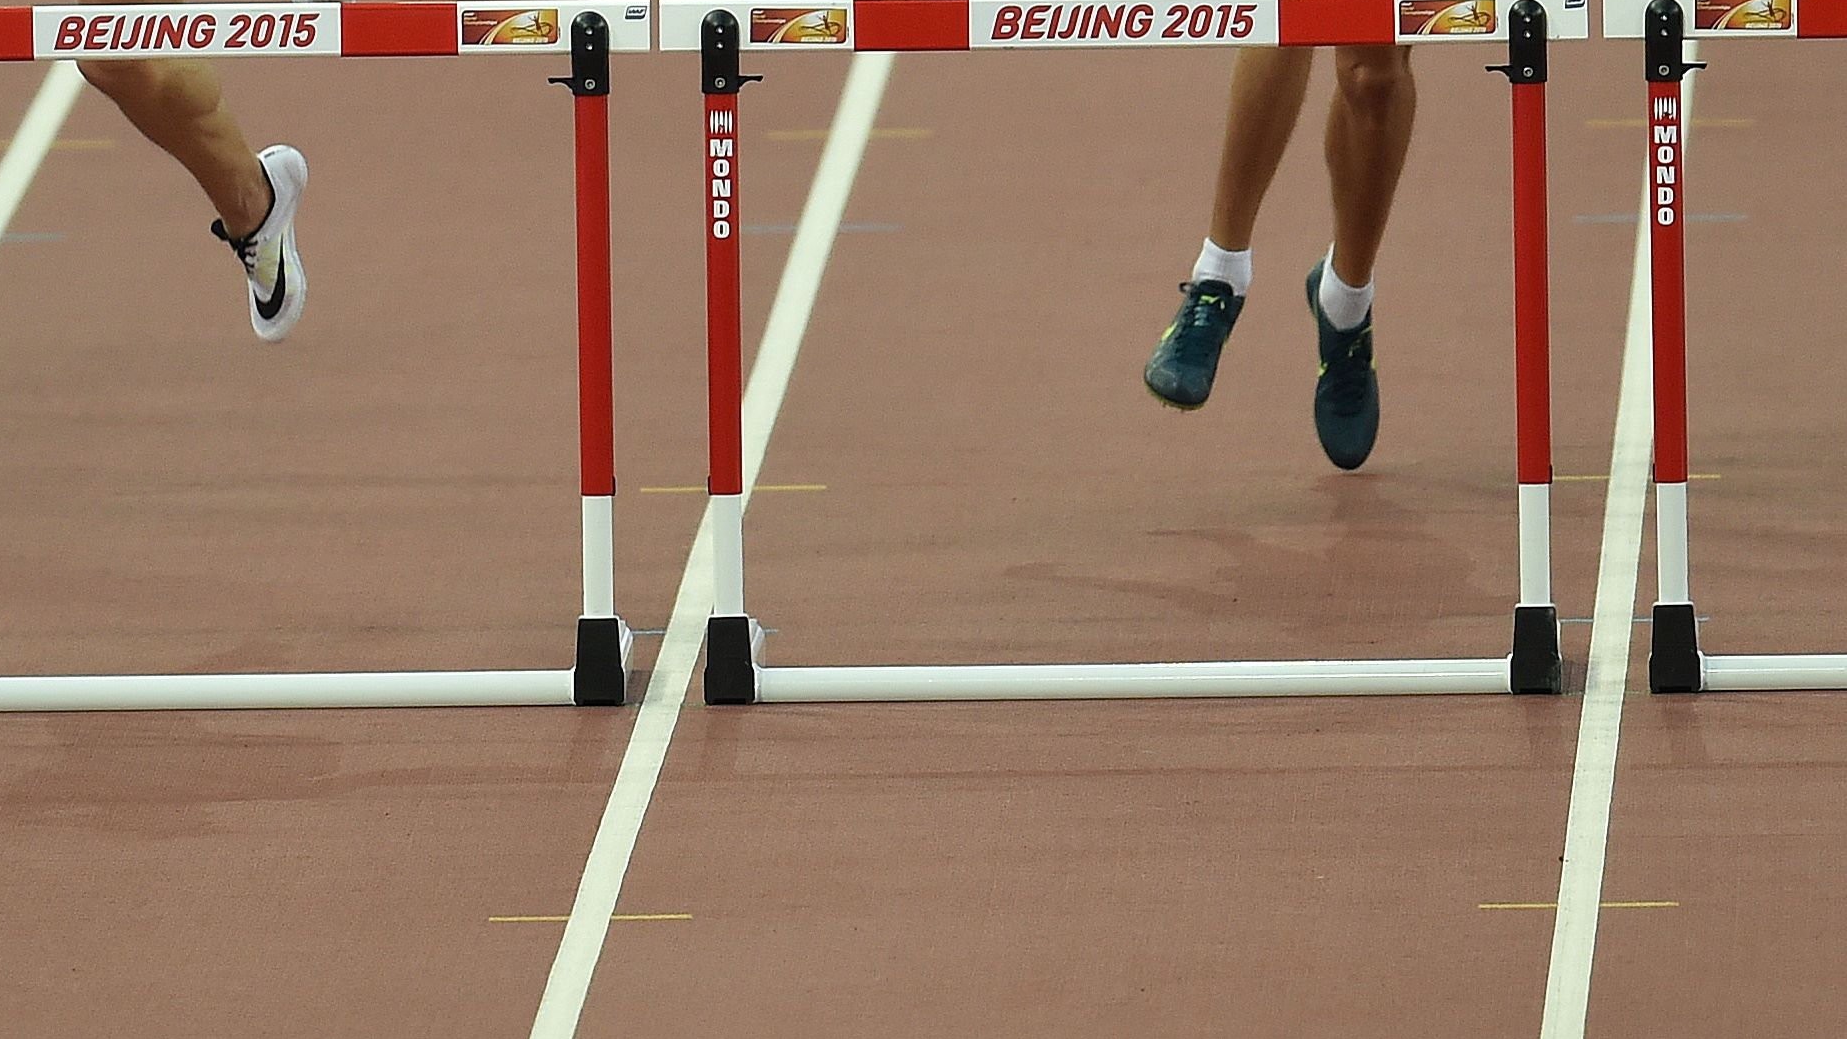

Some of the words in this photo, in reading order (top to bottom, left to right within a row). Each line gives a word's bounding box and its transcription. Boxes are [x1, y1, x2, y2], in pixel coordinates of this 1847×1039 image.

[54, 14, 217, 50] BEIJING
[224, 12, 321, 48] 2015
[991, 4, 1154, 40] BEIJING
[1161, 3, 1258, 39] 2015
[709, 138, 733, 239] MONDO
[1654, 125, 1677, 225] MONDO
